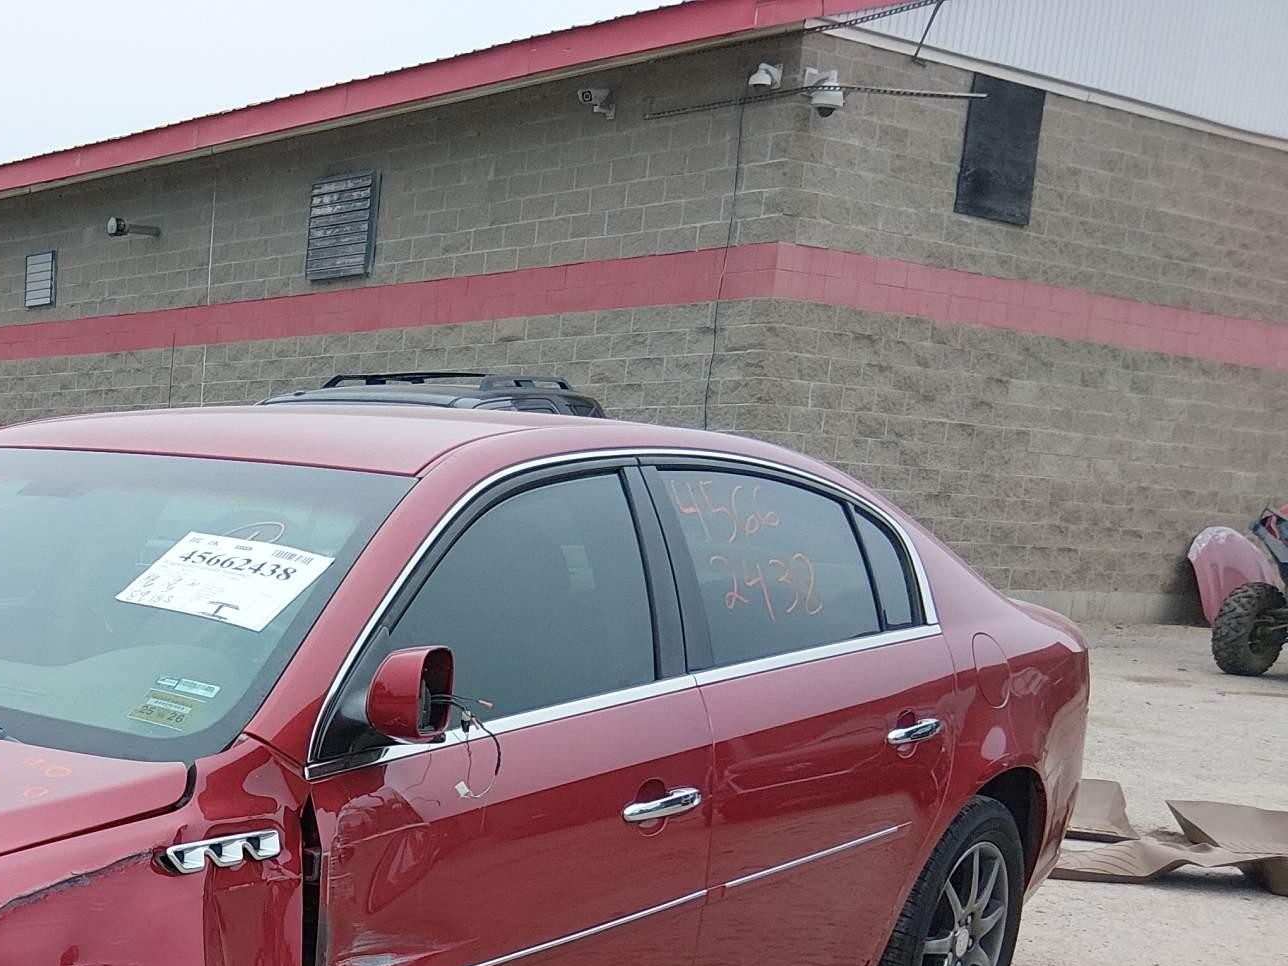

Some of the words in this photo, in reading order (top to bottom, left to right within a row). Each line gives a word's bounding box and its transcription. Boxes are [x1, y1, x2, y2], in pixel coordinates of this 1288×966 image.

[179, 550, 297, 581] 45662438
[138, 704, 155, 716] 25
[167, 712, 185, 724] 26
